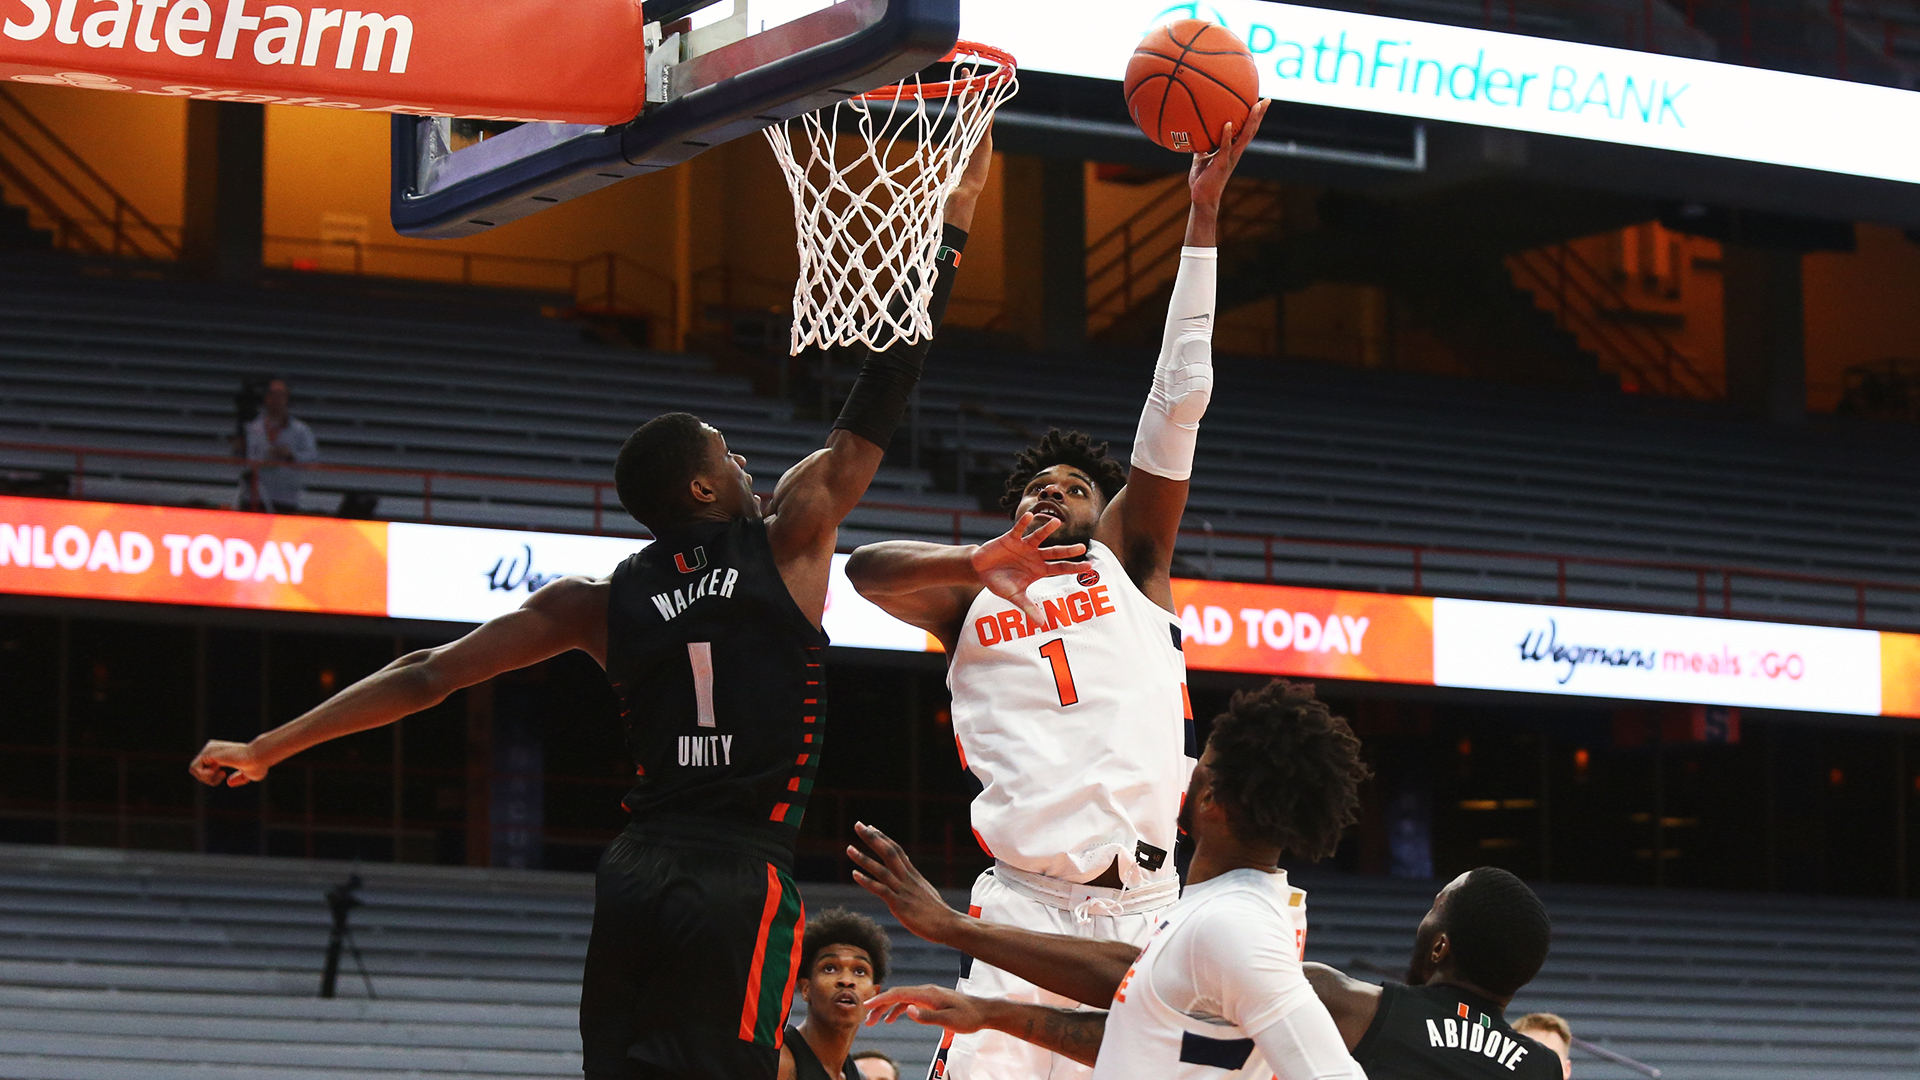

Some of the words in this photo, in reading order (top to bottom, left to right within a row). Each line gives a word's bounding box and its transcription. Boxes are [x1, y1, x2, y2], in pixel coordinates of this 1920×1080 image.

[1246, 22, 1539, 108] PathFinder
[1548, 64, 1690, 129] BANK
[162, 533, 313, 584] TODAY
[651, 567, 739, 622] WALKER
[974, 585, 1116, 647] ORANGE
[1240, 607, 1369, 655] TODAY
[1516, 618, 1656, 684] Wegmans
[1662, 643, 1741, 676] meals
[687, 641, 716, 728] 1
[1039, 638, 1078, 707] 1
[678, 734, 733, 767] UNITY
[1425, 1018, 1529, 1072] ABIDOYE
